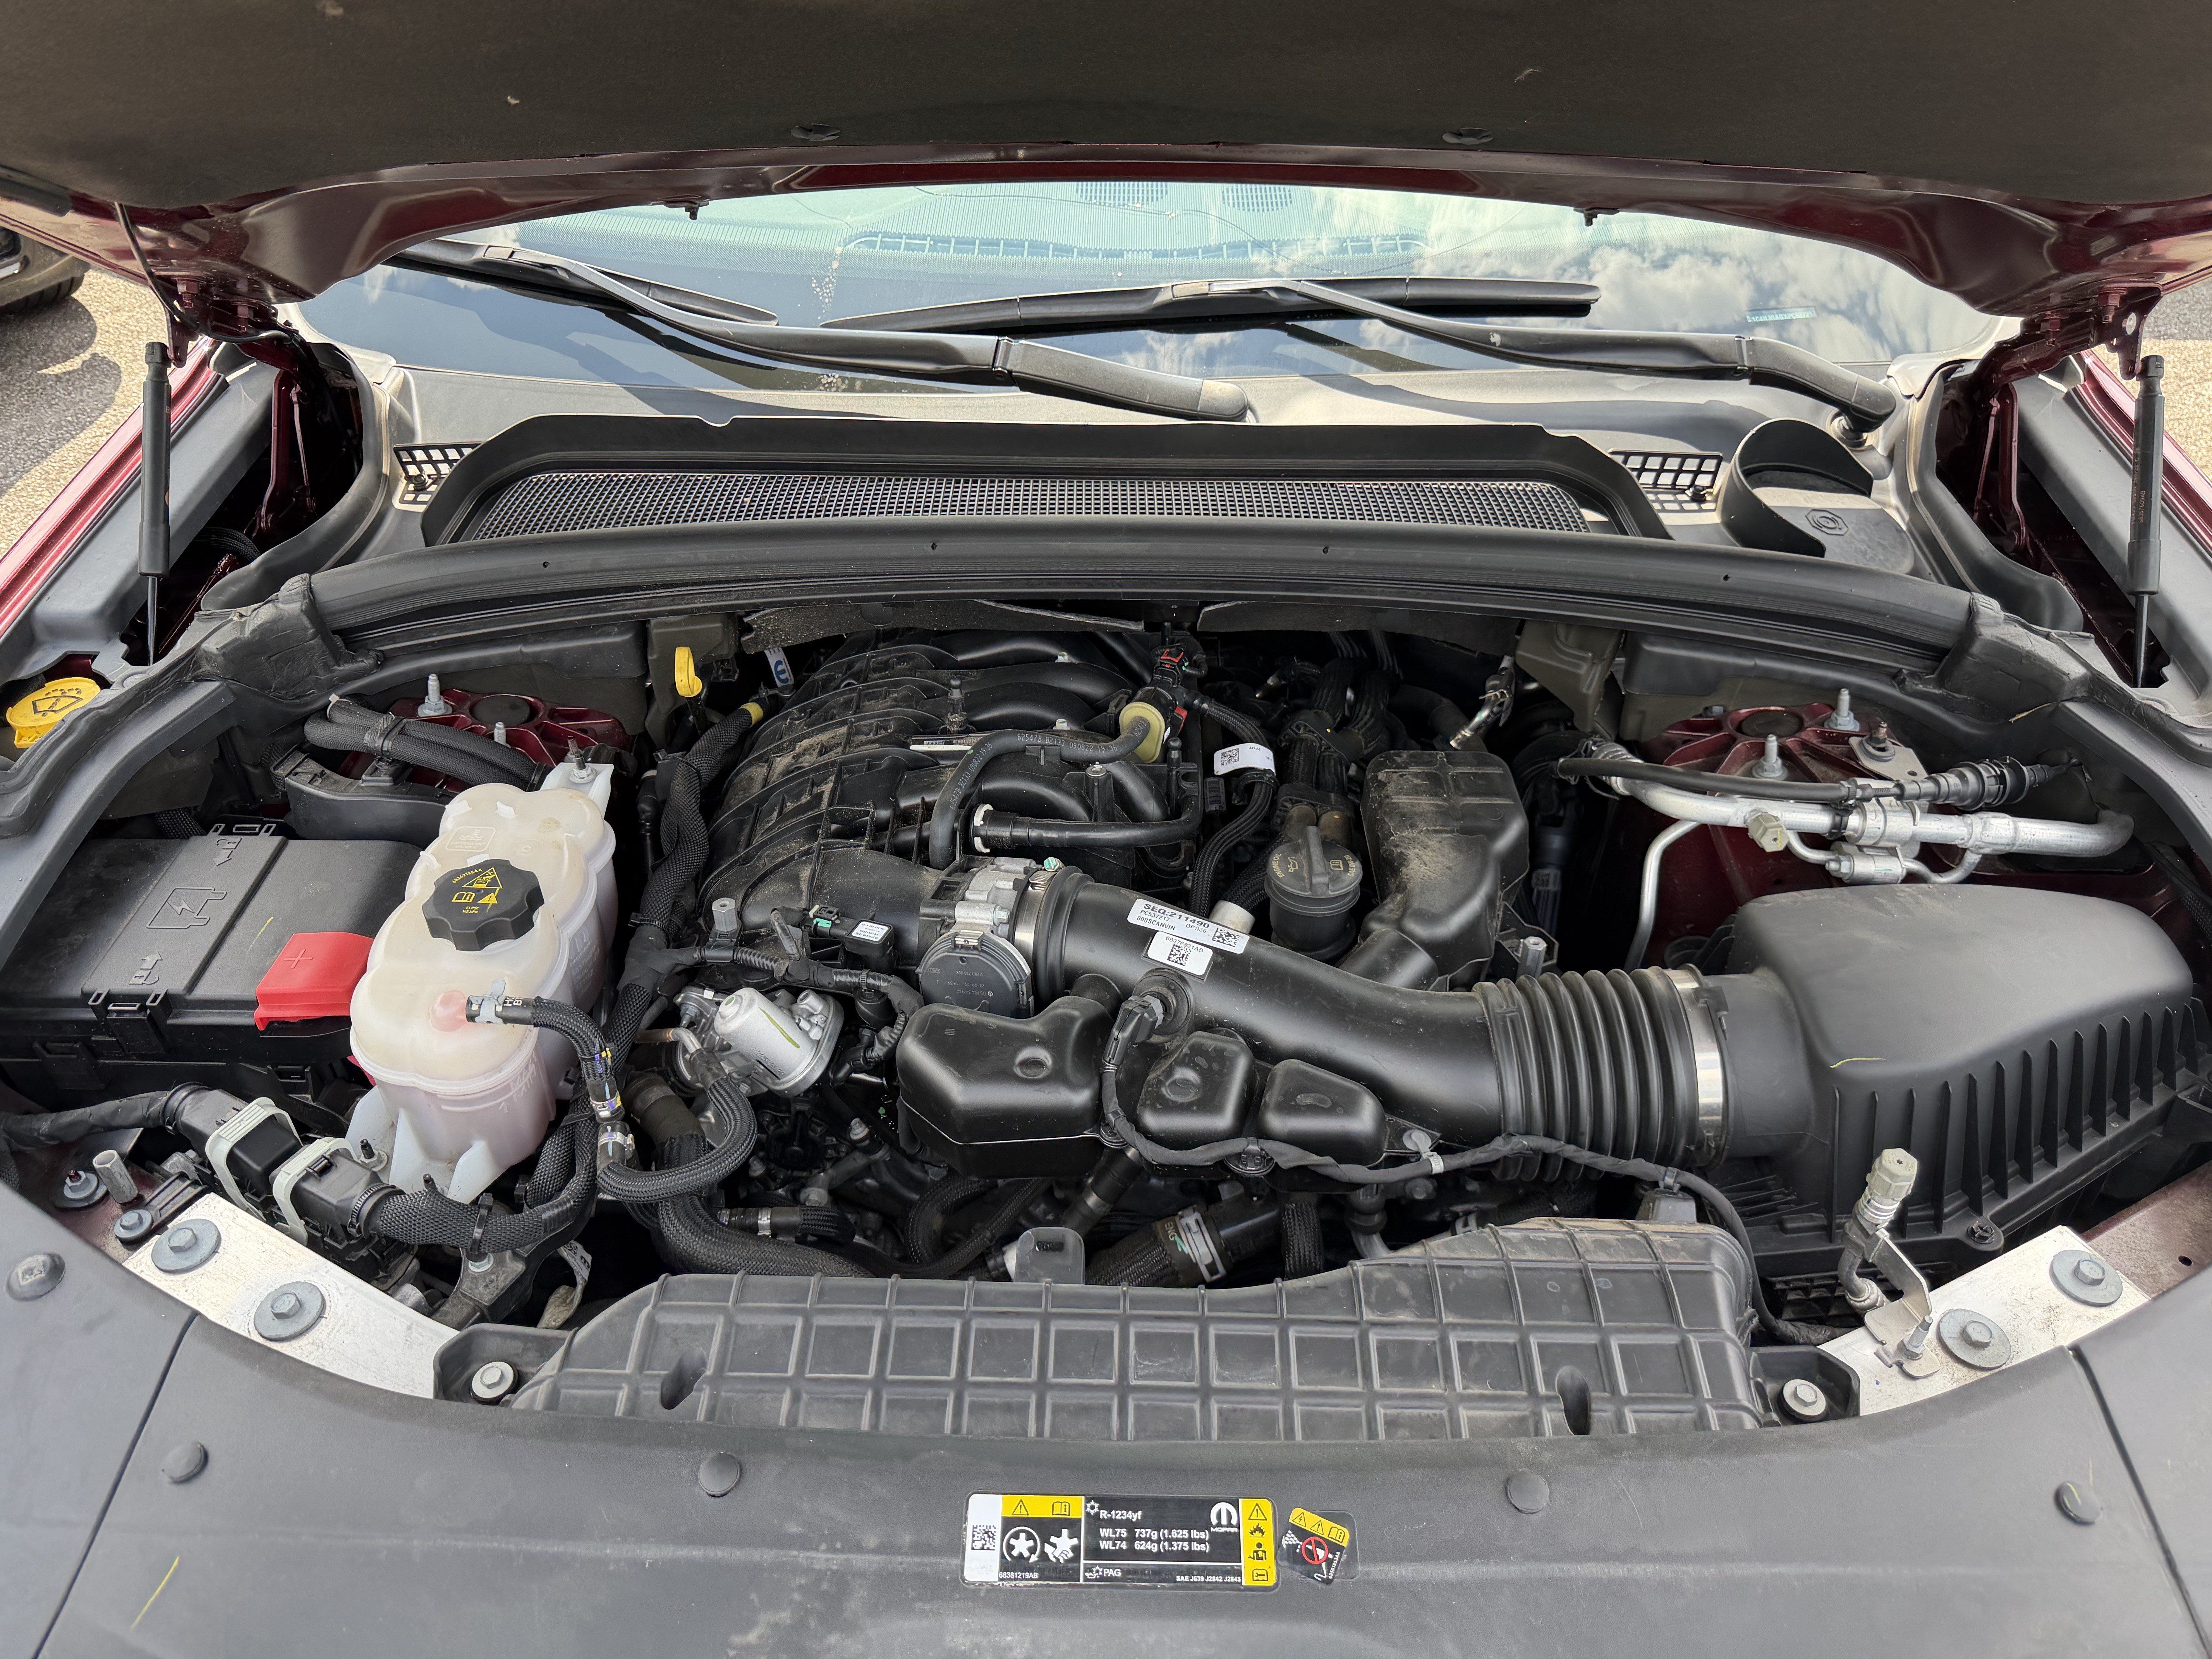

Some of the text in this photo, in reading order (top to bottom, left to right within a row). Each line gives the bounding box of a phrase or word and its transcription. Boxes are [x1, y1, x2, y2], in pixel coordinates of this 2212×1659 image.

[1140, 909, 1170, 922] PC537217
[1143, 903, 1210, 929] SEQ:211490
[1100, 1510, 1142, 1522] R-1234yf
[1099, 1528, 1209, 1541] WL75 737g (1.625 lbs)
[1099, 1540, 1209, 1553] WL74 624g (1.375 lbs)
[1103, 1568, 1121, 1577] PAG
